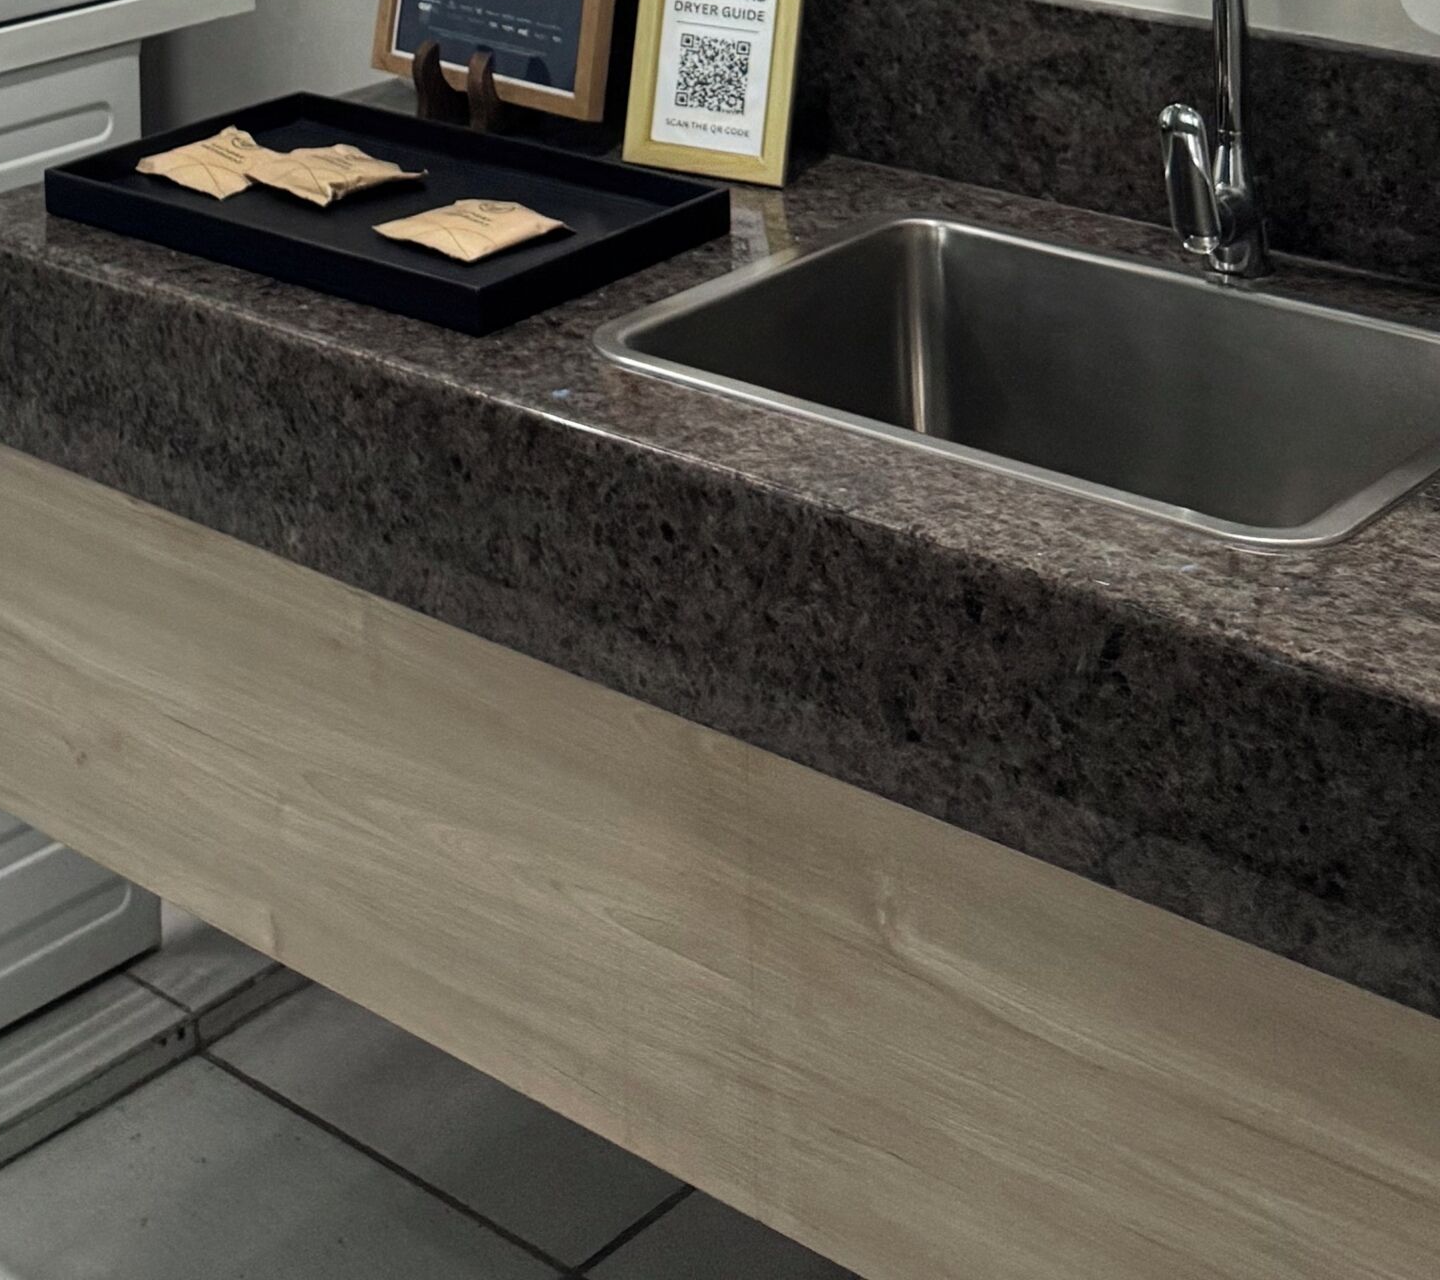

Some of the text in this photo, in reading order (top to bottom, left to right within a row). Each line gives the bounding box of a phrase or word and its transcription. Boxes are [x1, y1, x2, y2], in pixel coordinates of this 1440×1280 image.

[674, 0, 766, 23] DRYER GUIDE
[665, 118, 750, 138] SCAN THE QR CODE
